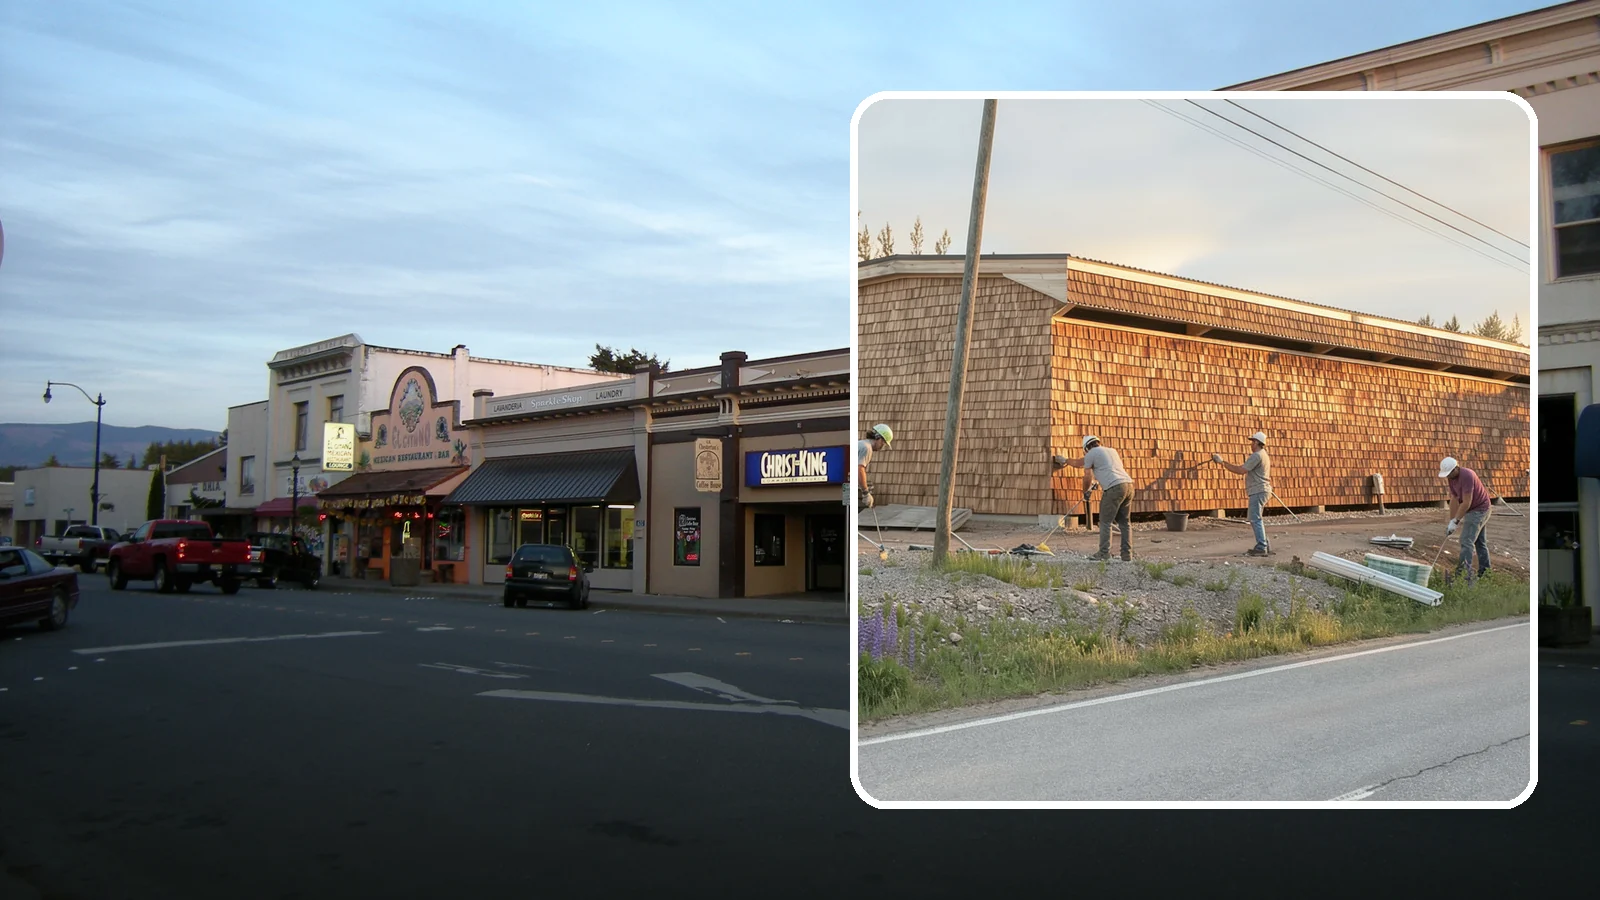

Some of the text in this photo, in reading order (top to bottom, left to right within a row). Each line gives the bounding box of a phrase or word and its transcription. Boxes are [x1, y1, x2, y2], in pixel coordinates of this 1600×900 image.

[531, 394, 582, 408] Sparkle Shop
[595, 389, 623, 400] LAUNDRY
[493, 402, 522, 412] LAVANDERIA
[374, 455, 396, 464] MEXICAN
[398, 451, 433, 462] RESTAURANT
[438, 450, 450, 459] BAR
[761, 450, 827, 478] CHRIST KING
